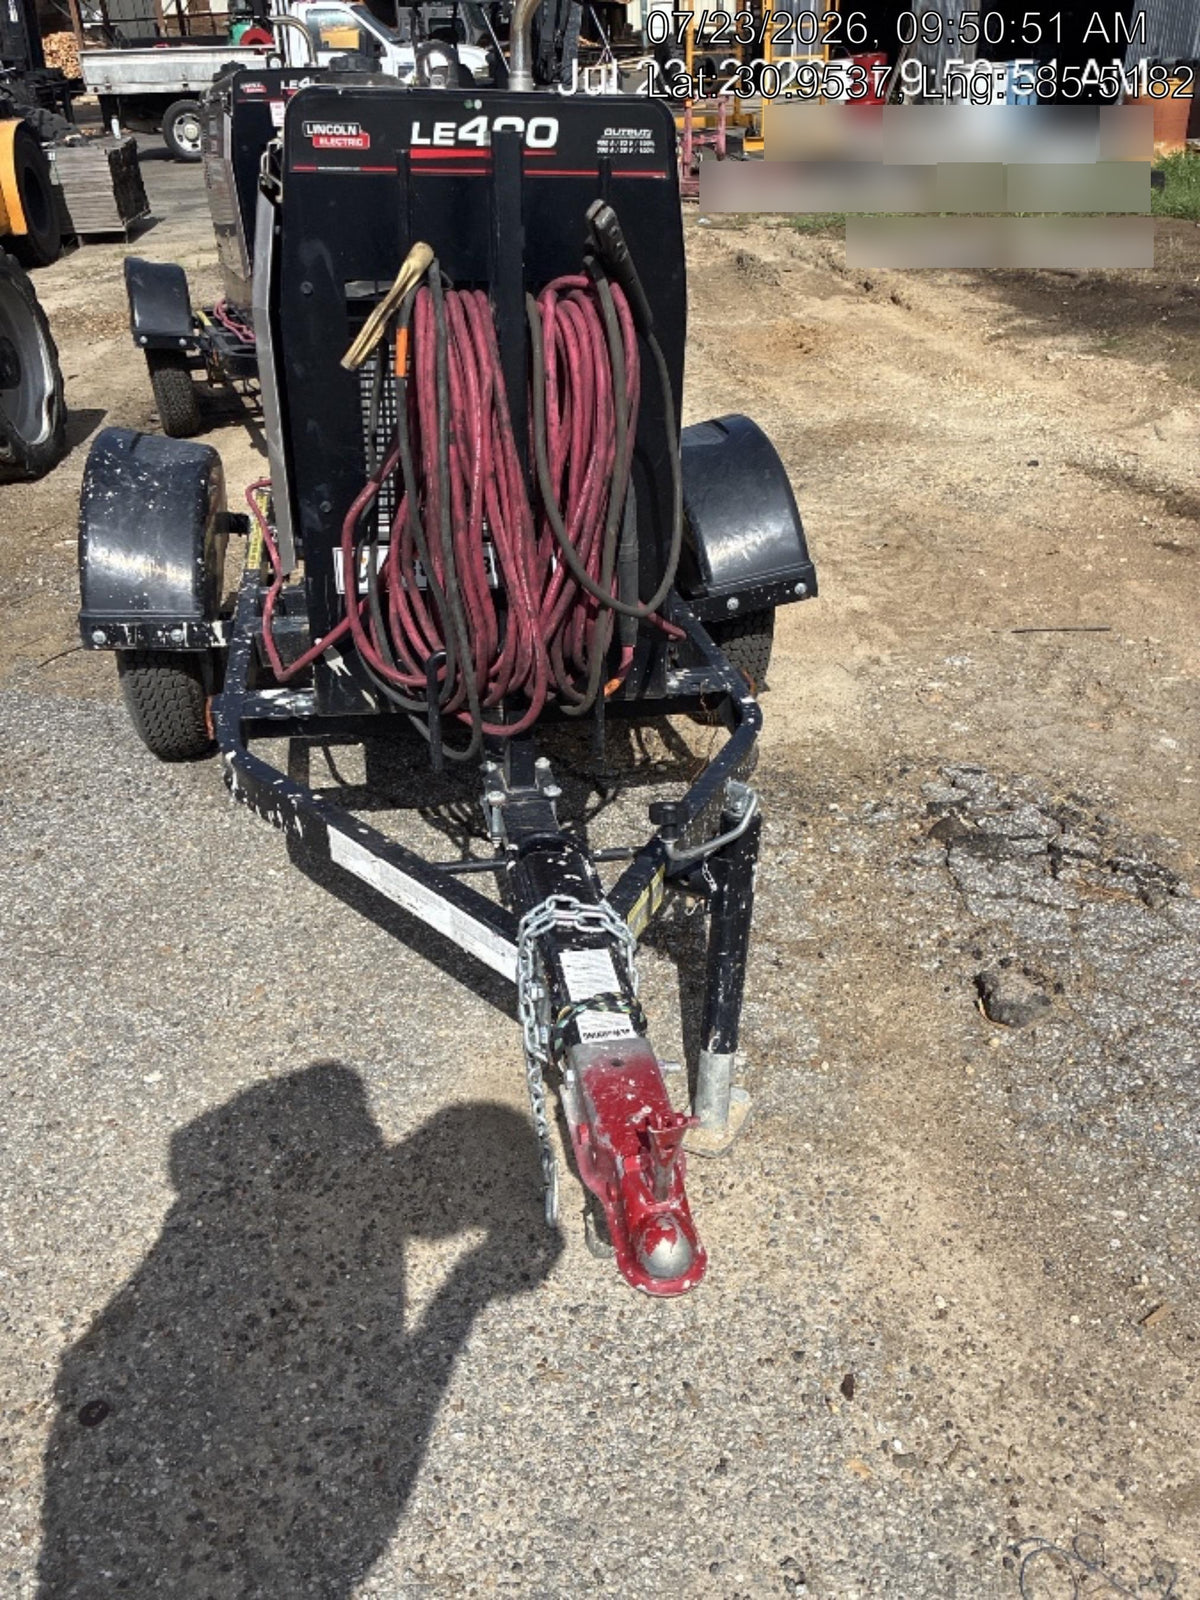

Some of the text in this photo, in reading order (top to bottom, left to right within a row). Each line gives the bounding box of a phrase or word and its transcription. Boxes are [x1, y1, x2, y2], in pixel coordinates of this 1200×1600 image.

[280, 76, 316, 90] LE4
[306, 123, 357, 136] LINCOLN
[319, 137, 364, 148] ELECTRIC
